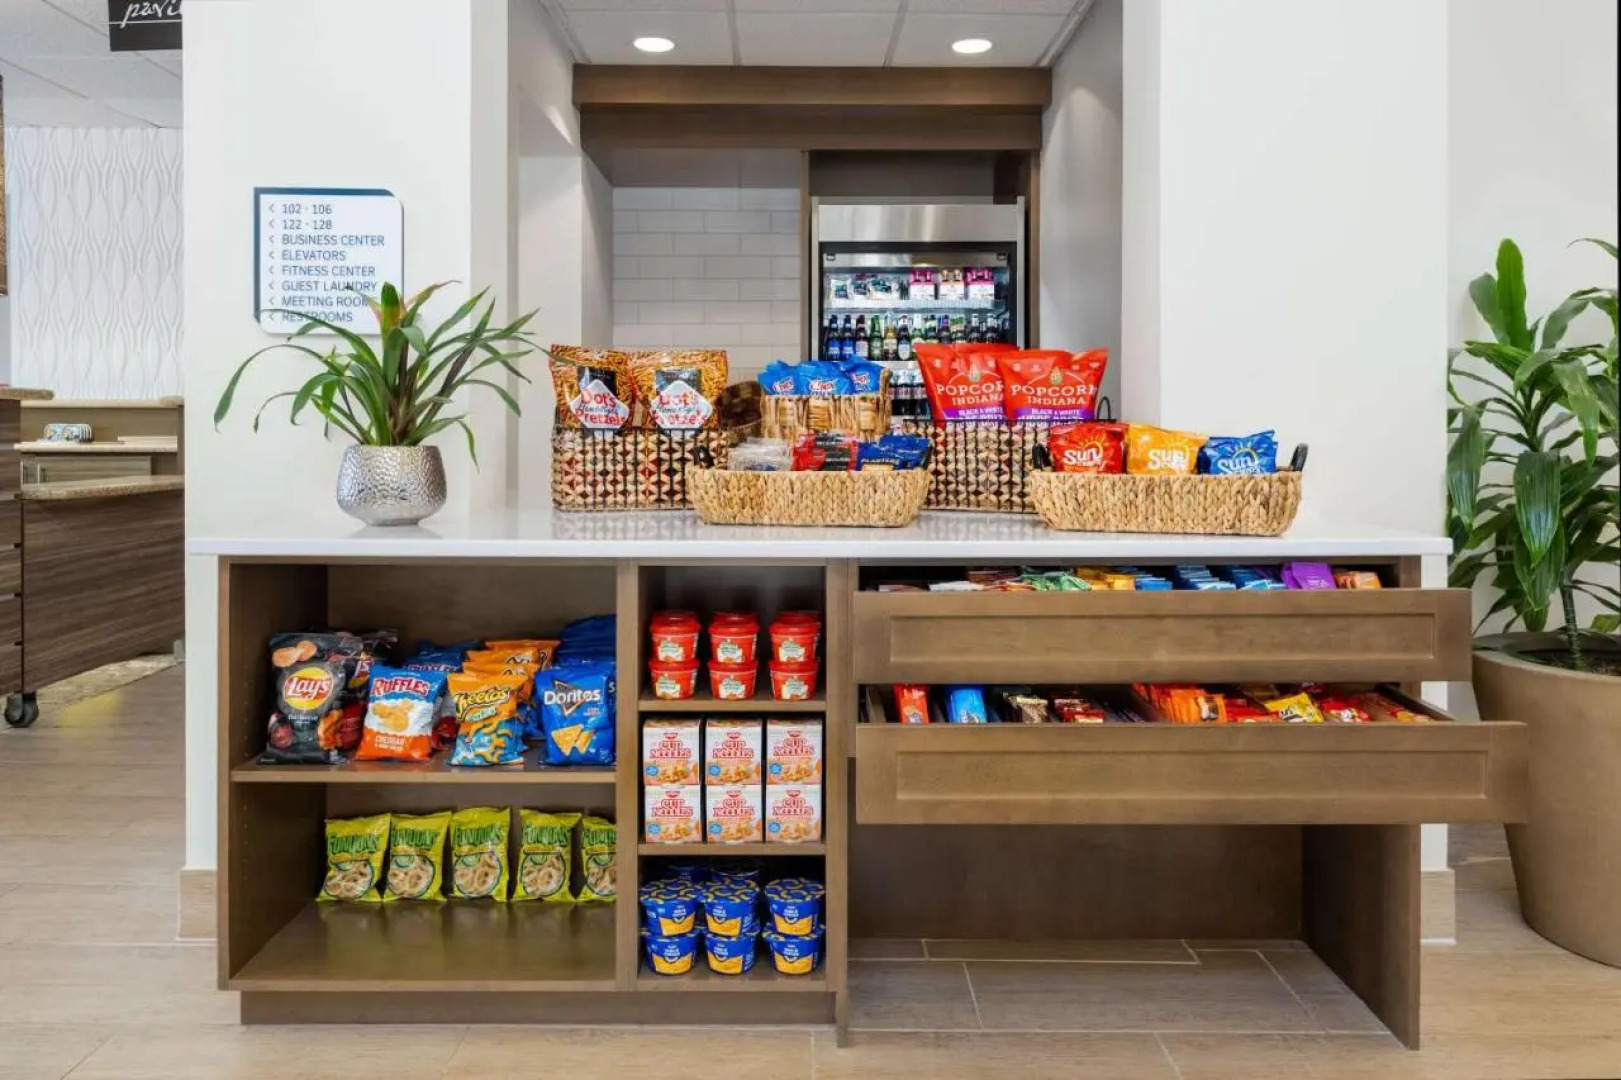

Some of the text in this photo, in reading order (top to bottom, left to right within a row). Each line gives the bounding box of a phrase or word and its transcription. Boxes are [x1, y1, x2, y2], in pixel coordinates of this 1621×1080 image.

[282, 204, 301, 214] 102
[312, 204, 333, 215] 106
[282, 220, 302, 230] 122
[313, 220, 333, 230] 128
[282, 234, 385, 246] BUSINESS CENTER
[282, 250, 346, 261] ELEVATORS
[282, 265, 376, 277] FITNESS CENTER
[281, 281, 377, 292] GUEST LAUNDRY
[282, 296, 333, 306] MEETING
[1011, 384, 1098, 397] POPCORN
[1027, 396, 1086, 406] INDIANA
[371, 676, 431, 697] RUFFLES
[544, 689, 601, 705] Doritos
